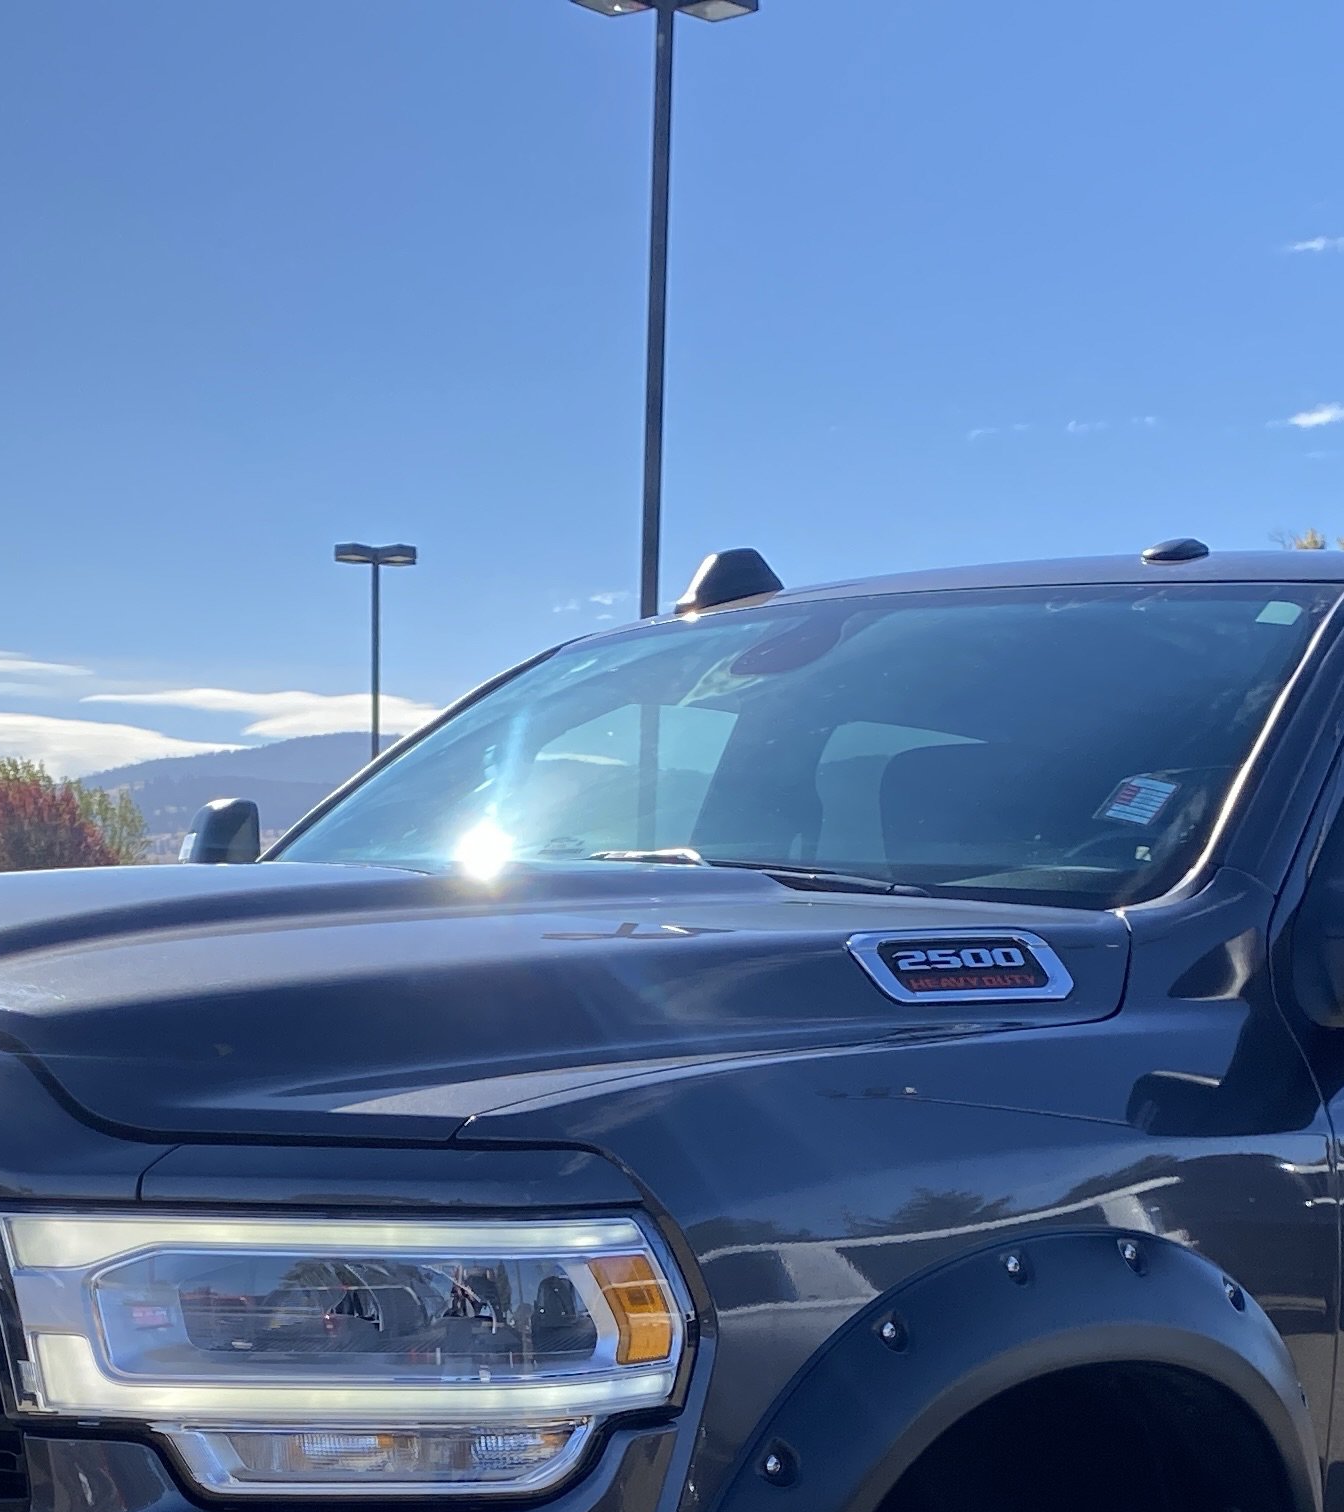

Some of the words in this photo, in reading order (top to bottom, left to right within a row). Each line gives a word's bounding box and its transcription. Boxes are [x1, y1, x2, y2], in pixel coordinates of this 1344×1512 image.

[892, 947, 1026, 971] 2500
[909, 975, 979, 990] HEAVY
[982, 974, 1036, 987] DUTY
